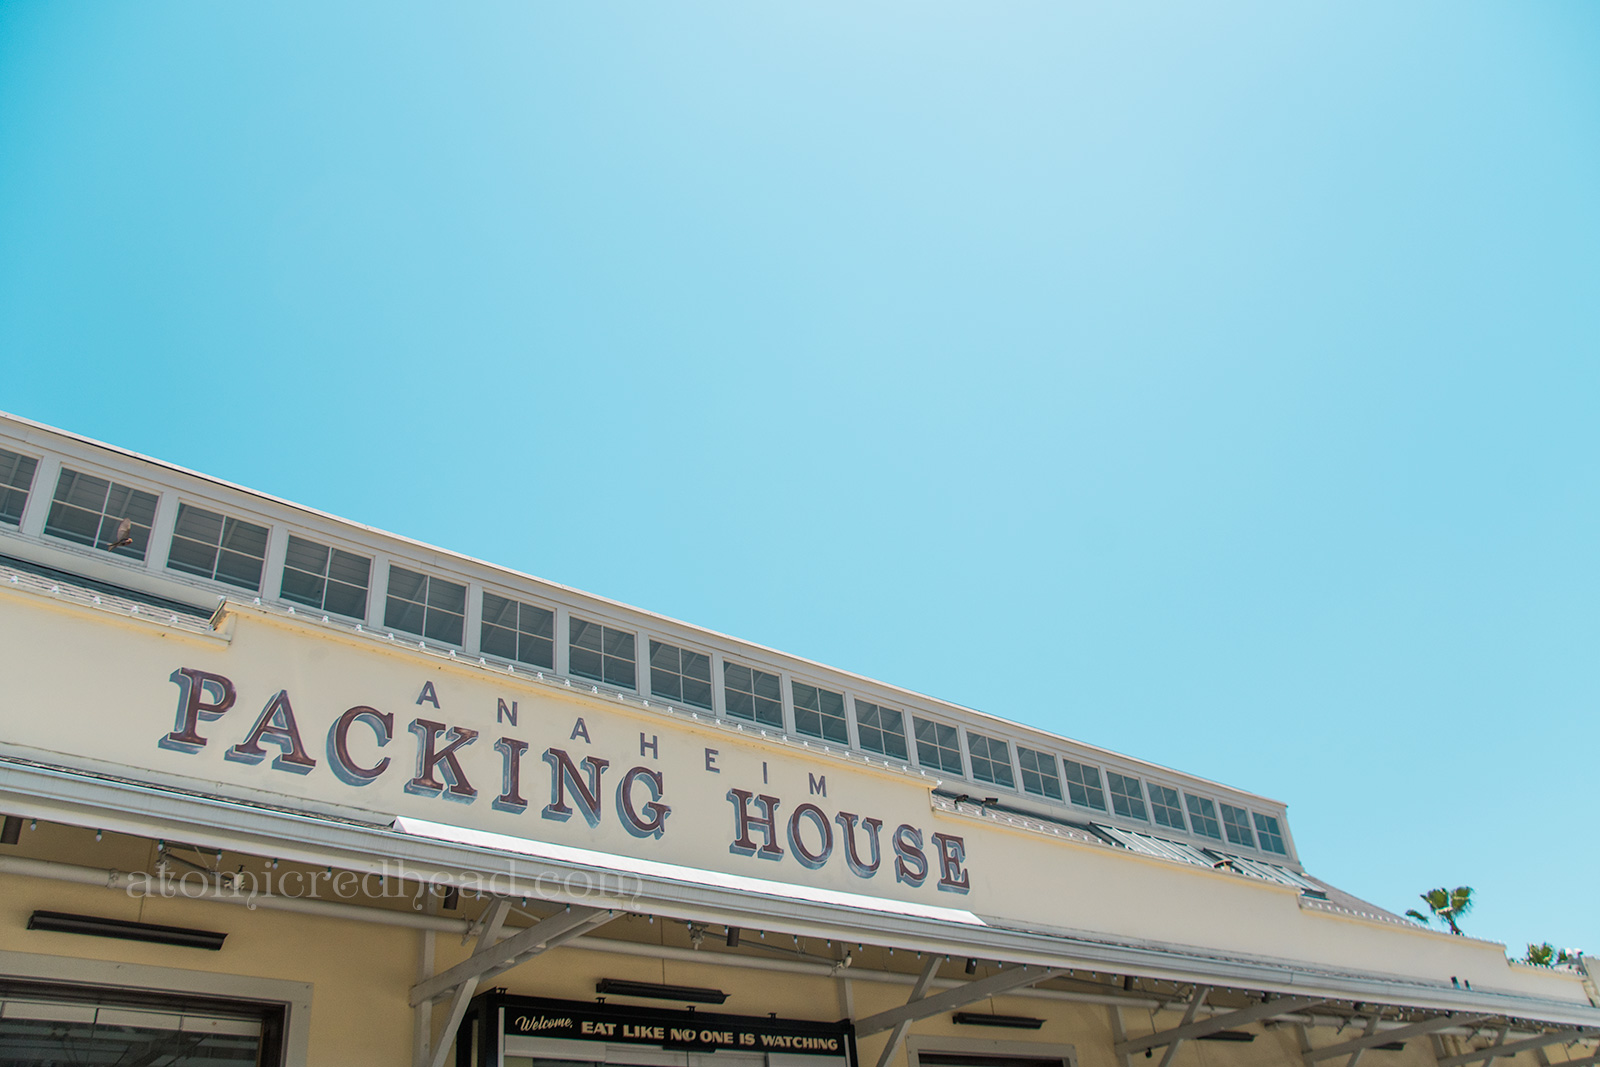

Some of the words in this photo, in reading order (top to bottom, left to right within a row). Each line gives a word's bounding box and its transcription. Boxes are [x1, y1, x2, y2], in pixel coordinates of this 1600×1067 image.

[157, 666, 672, 841] PACKING
[726, 787, 970, 896] HOUSE
[416, 680, 827, 798] ANAHEIM
[581, 1020, 617, 1036] EAT
[622, 1024, 665, 1040] LIKE
[669, 1027, 697, 1042] NO
[699, 1029, 734, 1045] ONE
[739, 1032, 756, 1046] IS
[760, 1034, 839, 1051] WATCHING
